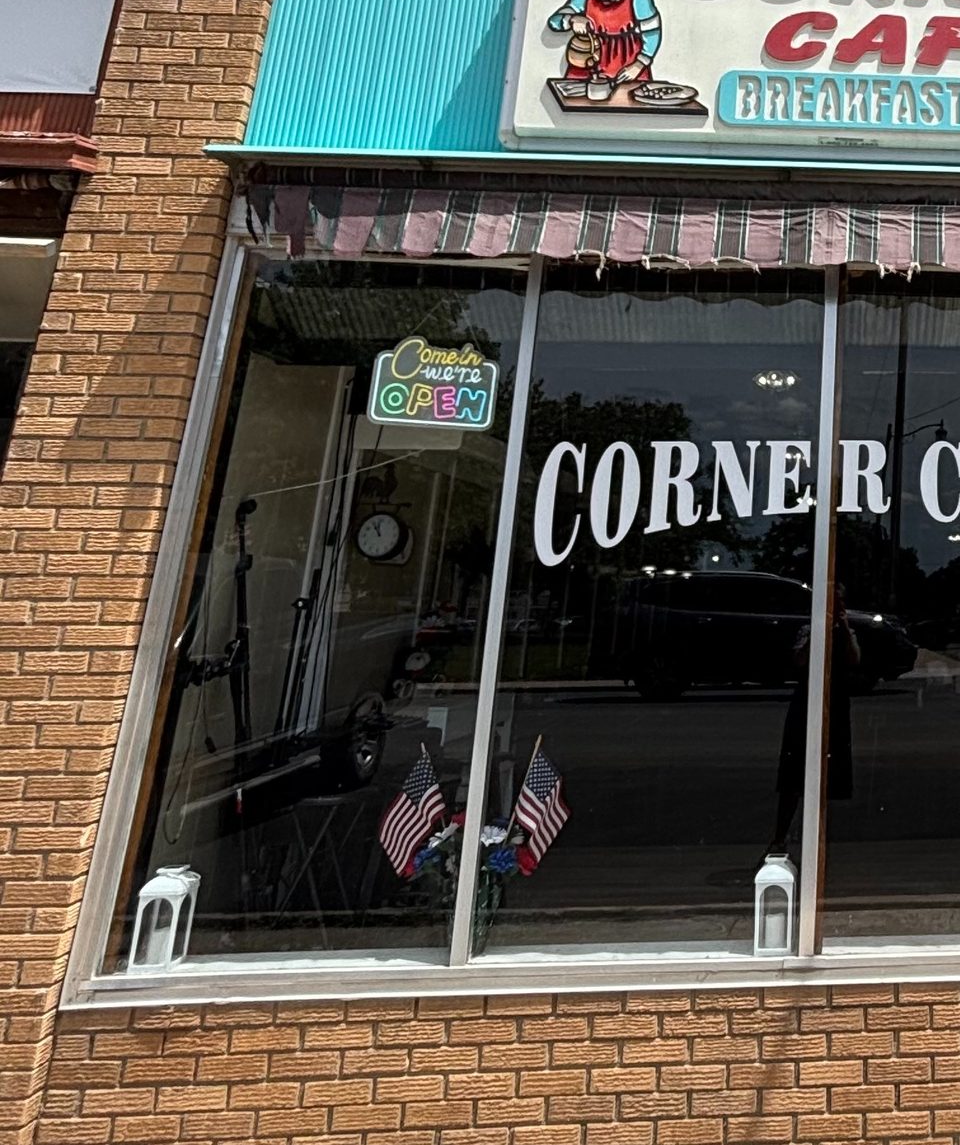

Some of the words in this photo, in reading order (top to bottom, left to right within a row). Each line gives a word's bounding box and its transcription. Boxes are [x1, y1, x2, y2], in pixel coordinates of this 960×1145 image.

[419, 364, 483, 384] we're
[380, 383, 487, 422] OPEN
[533, 439, 892, 567] CORNER
